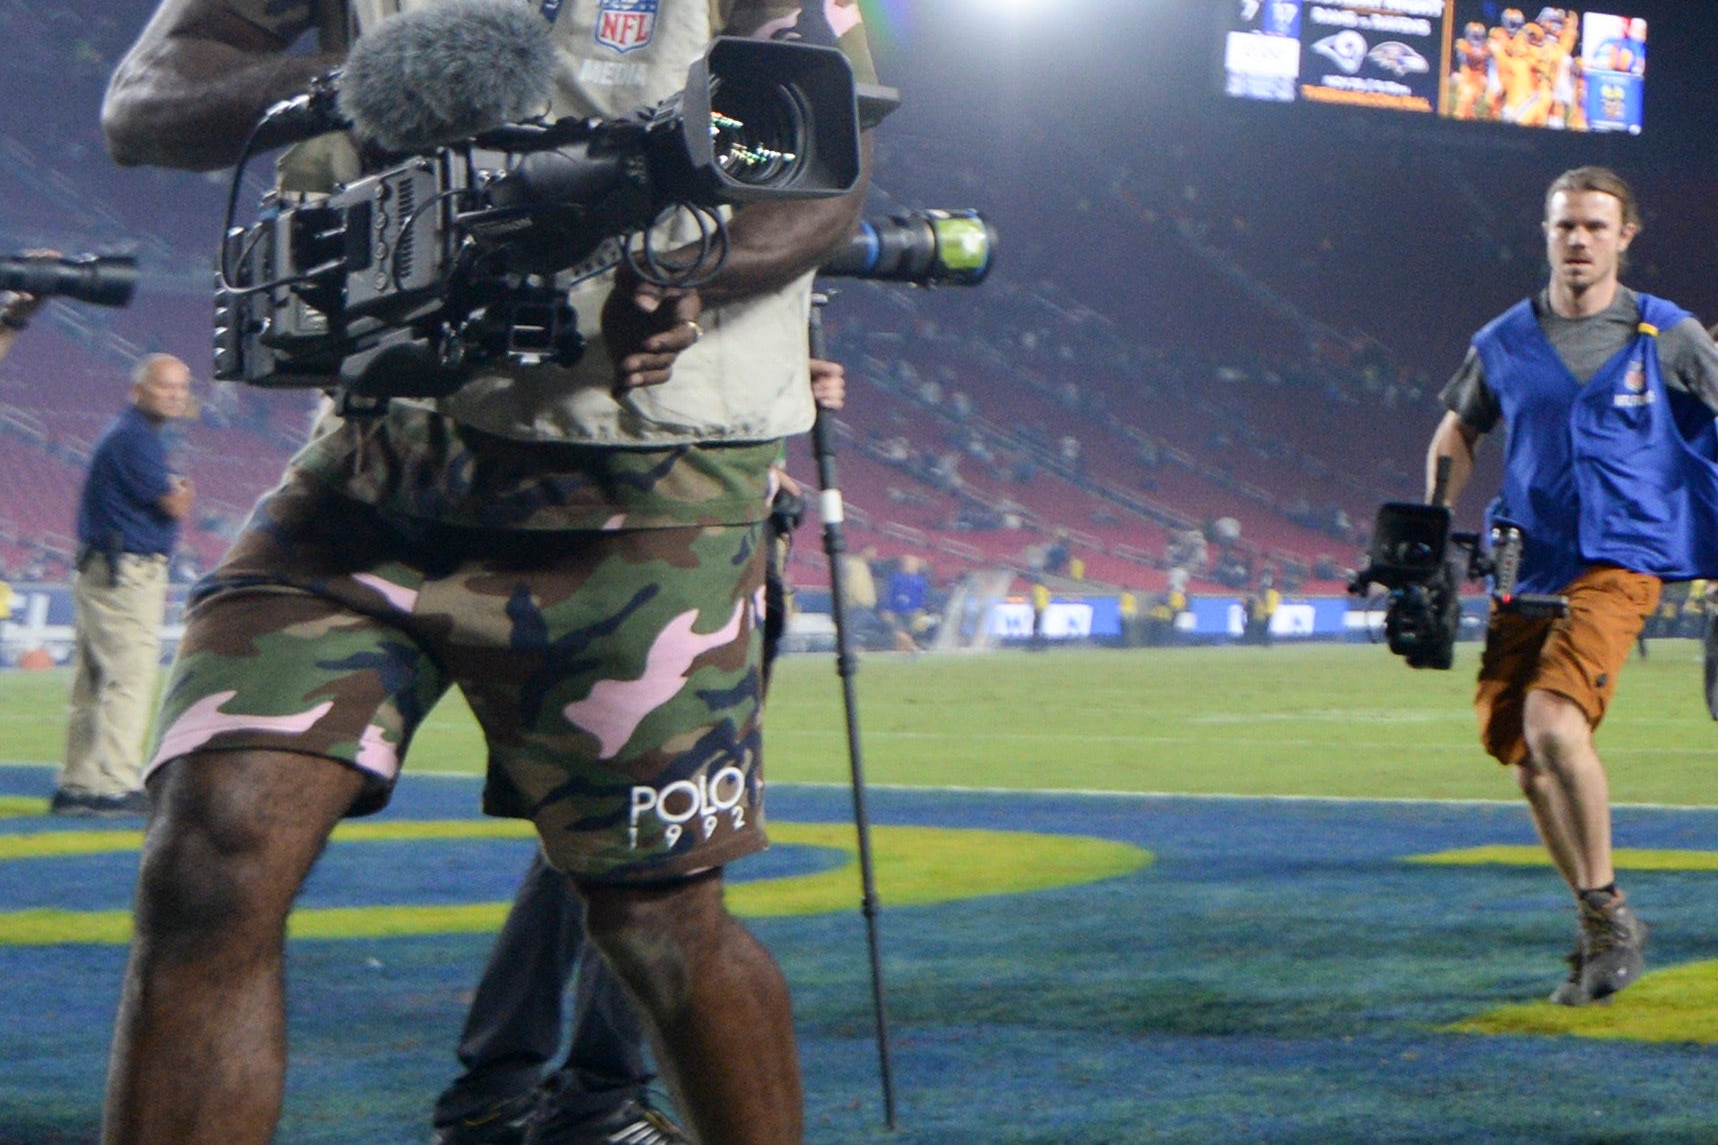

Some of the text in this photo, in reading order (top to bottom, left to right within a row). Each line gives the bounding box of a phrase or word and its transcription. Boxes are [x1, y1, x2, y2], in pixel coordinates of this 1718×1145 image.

[600, 12, 650, 45] NFL
[579, 59, 650, 86] MEDIA
[630, 766, 745, 828] POLO
[628, 805, 746, 852] 1992
